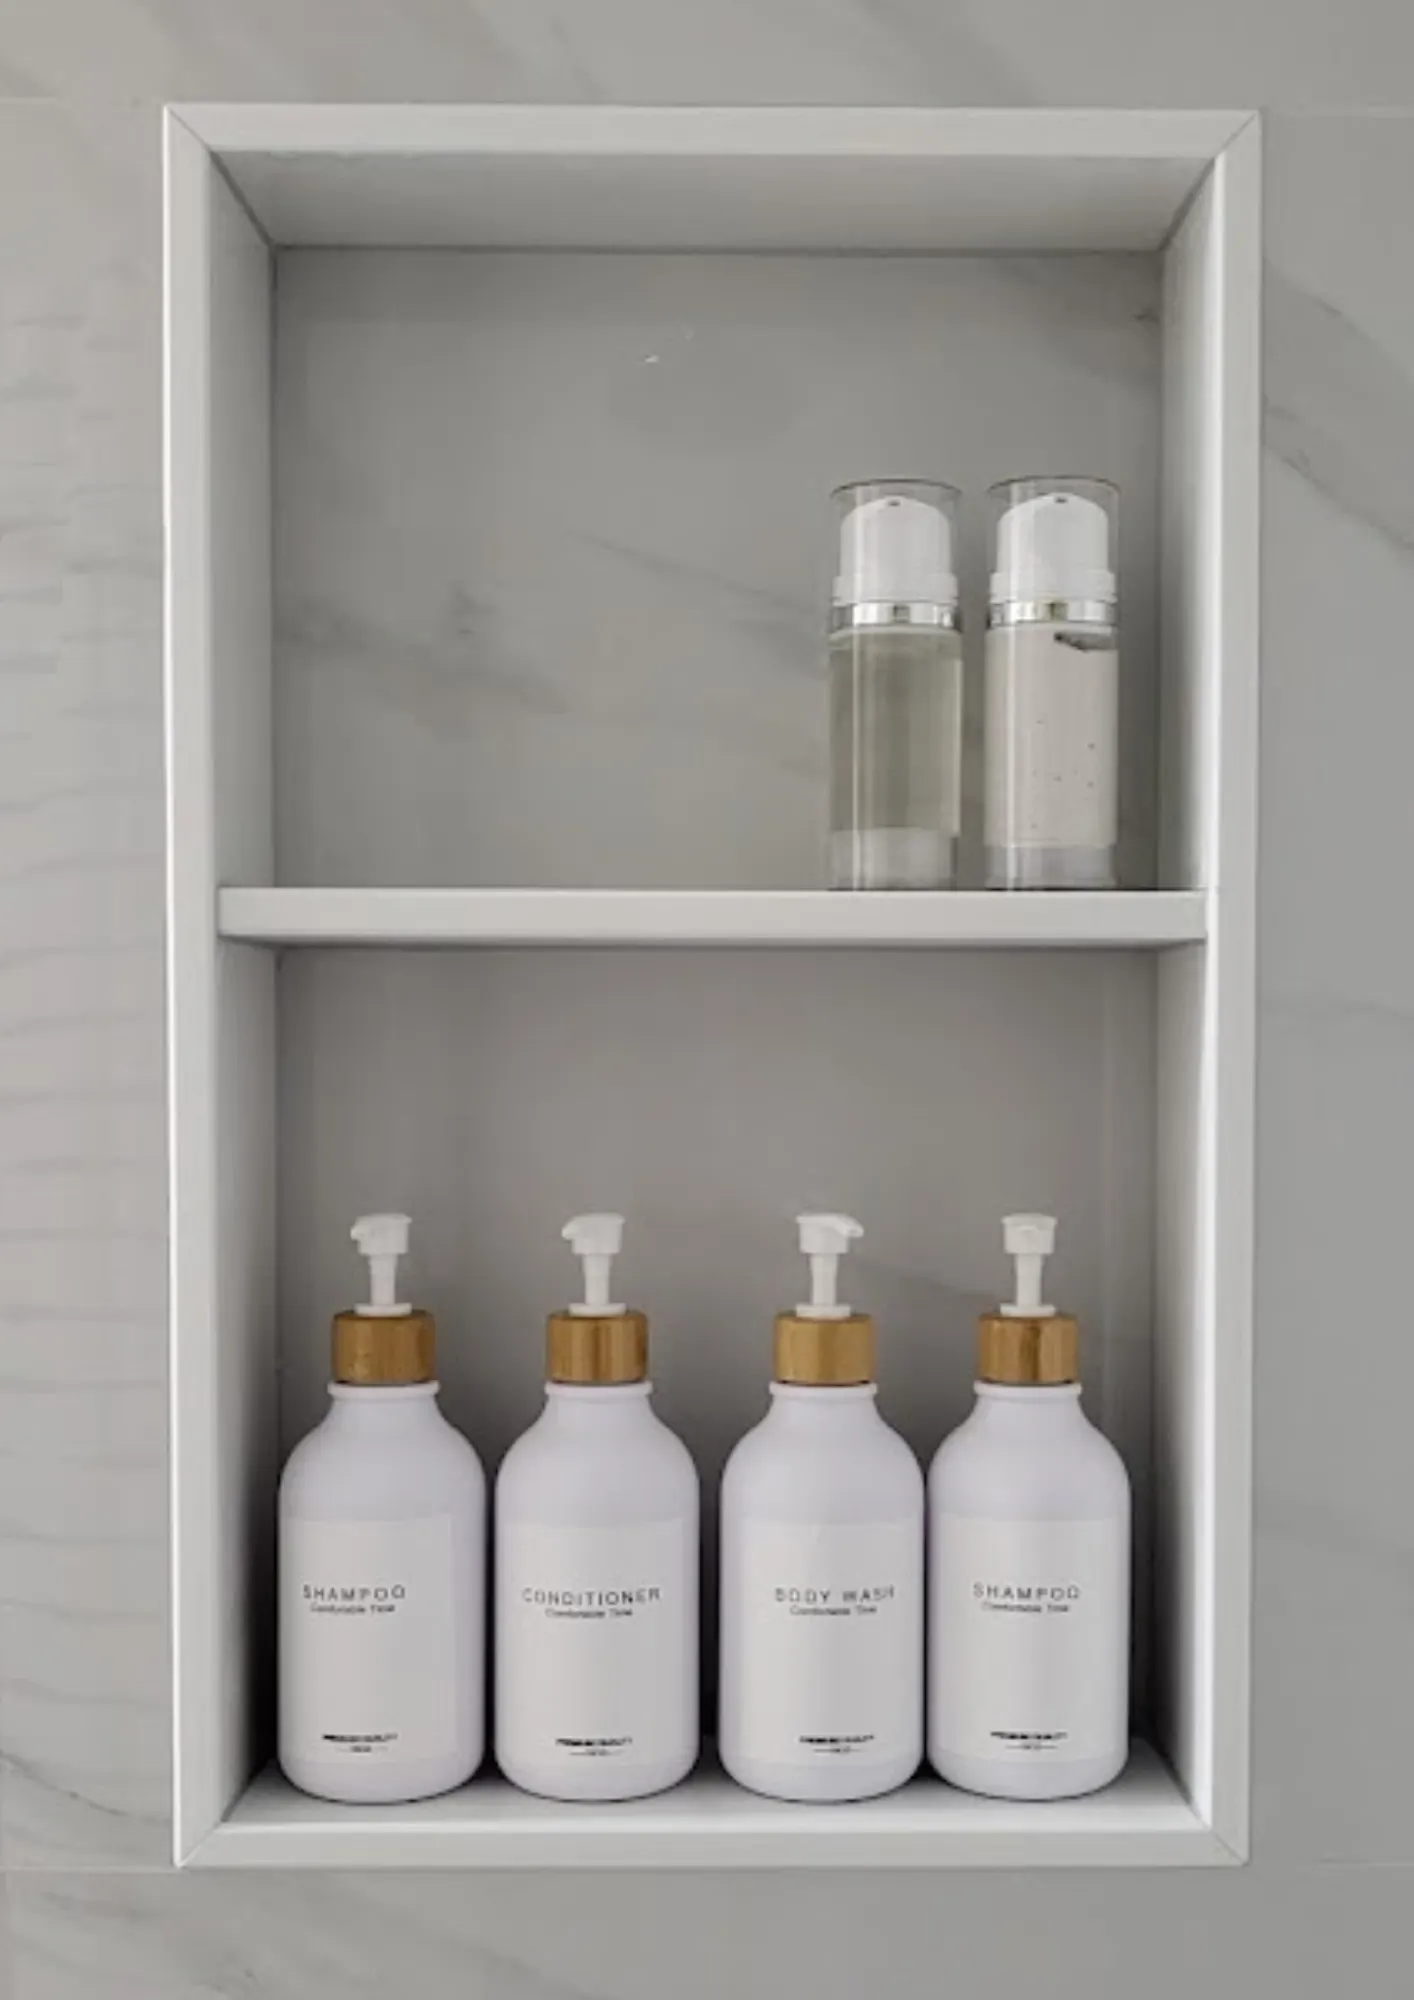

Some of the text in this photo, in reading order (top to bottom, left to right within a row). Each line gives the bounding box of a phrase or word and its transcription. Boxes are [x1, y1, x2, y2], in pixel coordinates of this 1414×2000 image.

[302, 1584, 406, 1602] SHAMPOO
[522, 1587, 661, 1606] CONDITIONER
[775, 1587, 831, 1604] BODY
[972, 1582, 1081, 1602] SHAMPOO
